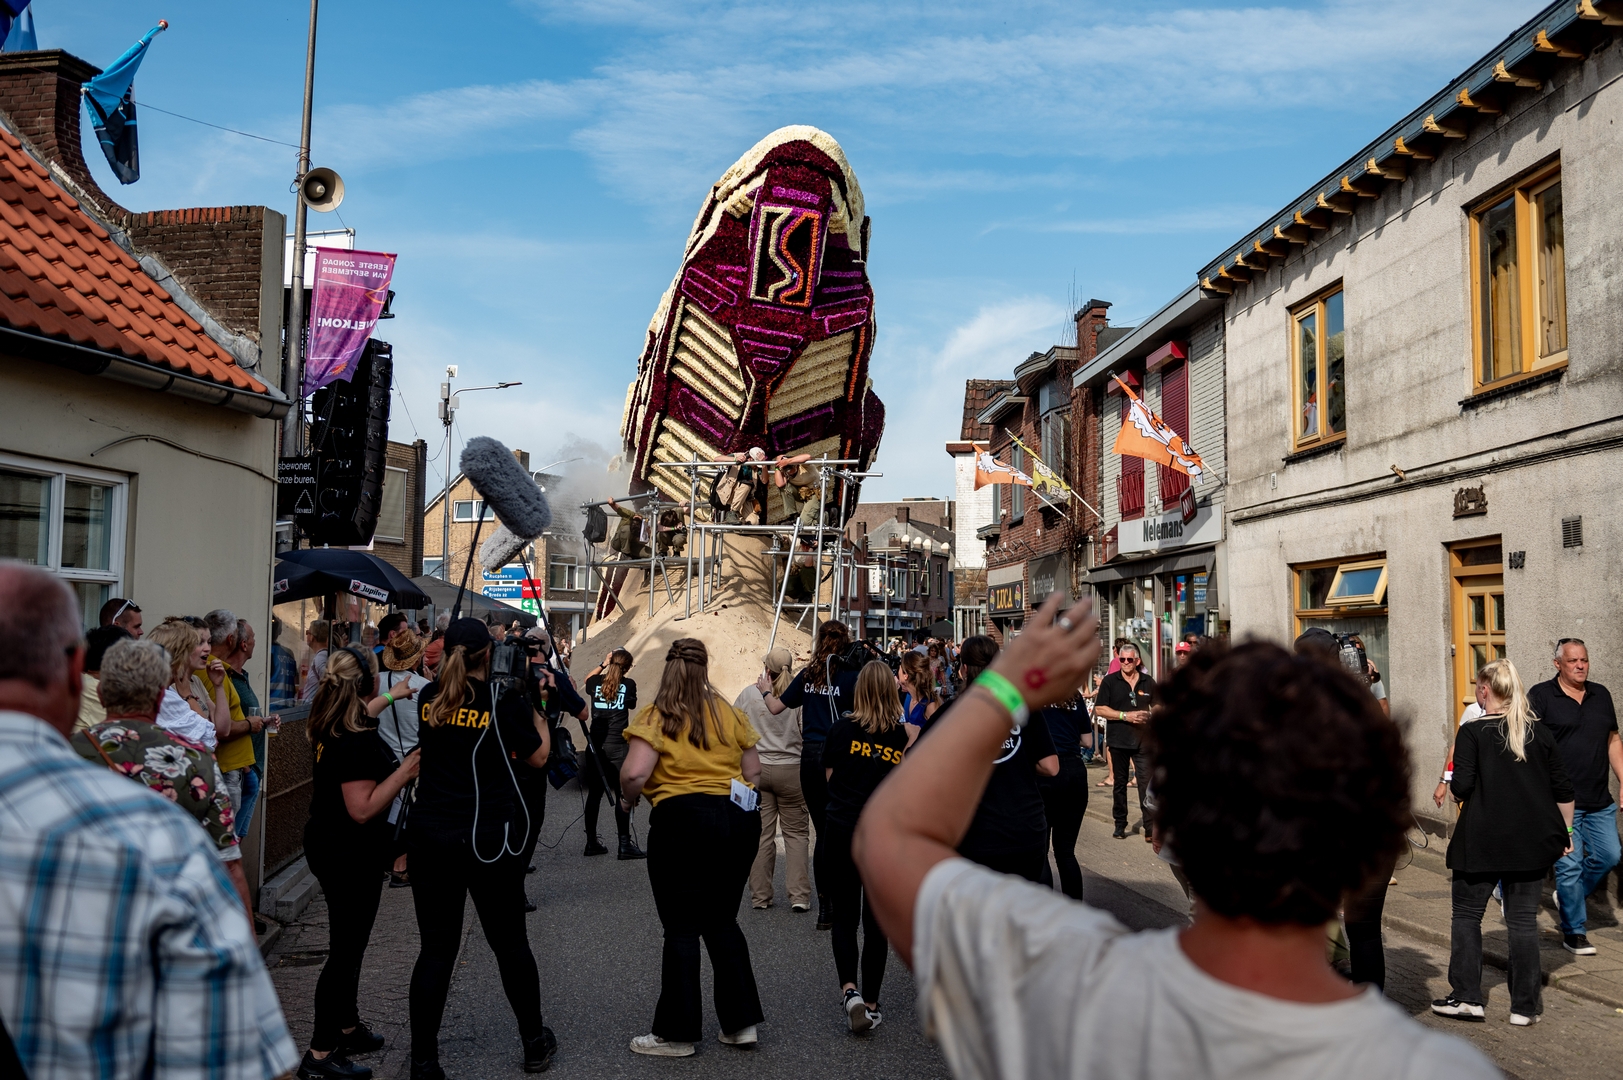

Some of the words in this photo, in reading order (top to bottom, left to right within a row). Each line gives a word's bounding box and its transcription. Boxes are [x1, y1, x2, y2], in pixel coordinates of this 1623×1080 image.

[293, 474, 316, 484] buren.
[1143, 518, 1184, 543] Nelemans
[360, 585, 387, 598] Jupiler
[996, 587, 1013, 609] LUCA
